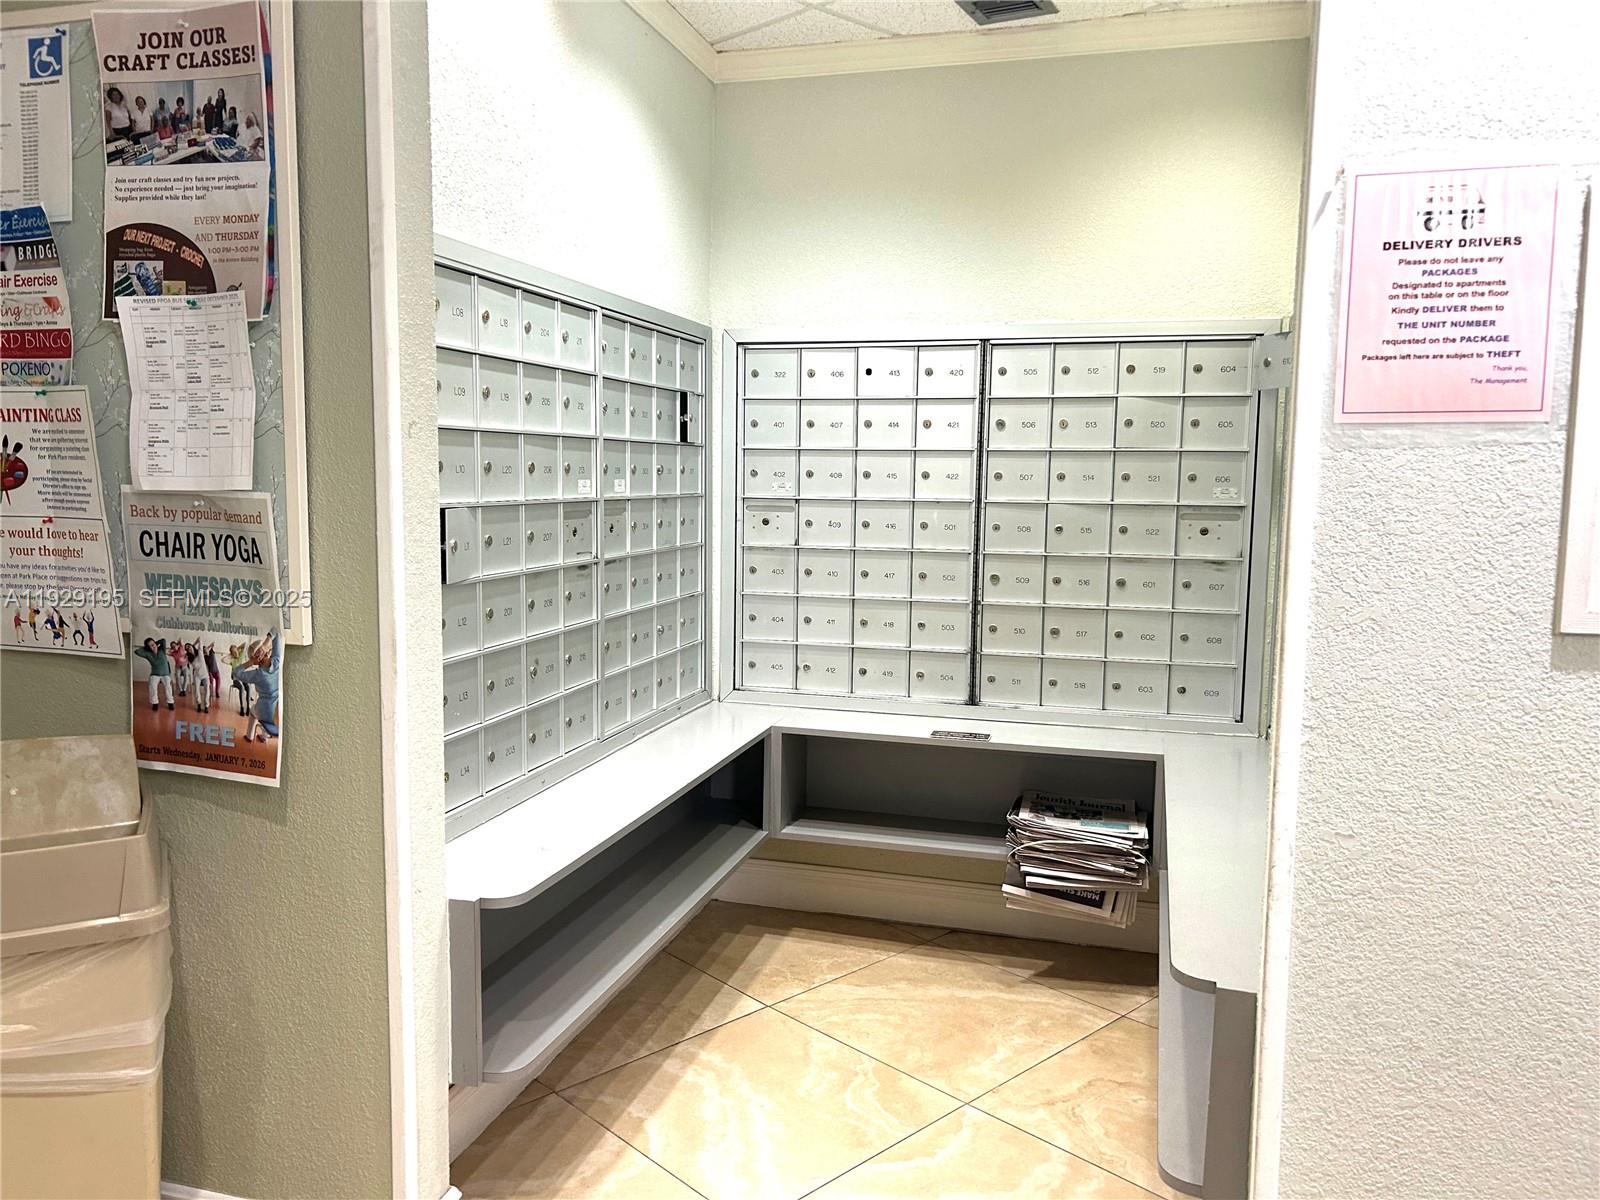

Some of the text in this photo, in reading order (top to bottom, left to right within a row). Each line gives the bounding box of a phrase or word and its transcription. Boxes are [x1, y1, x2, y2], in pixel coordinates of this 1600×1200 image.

[137, 27, 226, 49] JOIN OUR
[104, 46, 256, 72] CRAFT CLASSES!
[194, 214, 259, 225] EVERY MONDAY
[195, 231, 259, 242] AND THURSDAY
[1383, 236, 1522, 251] DELIVERY DRIVERS
[18, 243, 57, 260] BRIDGE
[123, 229, 136, 241] OUR
[136, 230, 151, 244] NEXT
[151, 233, 176, 253] PROJECT
[180, 246, 205, 268] CROCHET
[1488, 256, 1503, 264] any
[14, 273, 57, 287] Exercise
[1392, 281, 1442, 290] Designated
[1456, 279, 1506, 288] apartments
[1421, 291, 1442, 299] table
[452, 307, 464, 318] L08
[1391, 307, 1419, 315] Kindly
[499, 318, 509, 328] L18
[25, 331, 71, 347] BINGO
[1382, 337, 1426, 346] requested
[1460, 335, 1509, 343] PACKAGE
[1446, 352, 1473, 360] subject
[2, 362, 50, 376] POKENO
[888, 369, 901, 377] 413
[949, 369, 964, 377] 420
[1023, 368, 1038, 376] 505
[1087, 367, 1100, 375] 512
[1153, 366, 1166, 374] 519
[1220, 365, 1236, 373] 604
[830, 370, 845, 378] 406
[55, 408, 81, 422] CLASS
[773, 421, 785, 429] 401
[829, 421, 844, 429] 407
[1021, 421, 1036, 429] 506
[1085, 421, 1098, 429] 513
[1150, 420, 1166, 429] 520
[1217, 420, 1234, 429] 605
[886, 472, 898, 480] 415
[1019, 473, 1034, 481] 507
[1147, 475, 1161, 483] 521
[1214, 475, 1231, 483] 606
[130, 505, 262, 524] Back by popular demand
[827, 520, 842, 529] 409
[943, 523, 956, 531] 501
[1016, 525, 1032, 533] 508
[1145, 528, 1160, 536] 522
[8, 528, 98, 541] would love to hear
[140, 530, 262, 564] CHAIR YOGA
[9, 545, 84, 560] your thoughts!
[827, 570, 839, 578] 410
[942, 574, 956, 582] 502
[1015, 576, 1030, 584] 509
[144, 573, 263, 605] WEDNESDAYS
[1142, 581, 1156, 589] 601
[1208, 583, 1225, 591] 607
[156, 616, 258, 635] Clubhouse Auditorium
[1013, 627, 1026, 635] 510
[1140, 633, 1156, 641] 602
[1206, 636, 1223, 645] 608
[1137, 685, 1153, 693] 603
[1203, 689, 1220, 698] 609
[176, 721, 235, 747] FREE
[139, 744, 265, 769] Starts Wednesday, JANUARY 7, 2026
